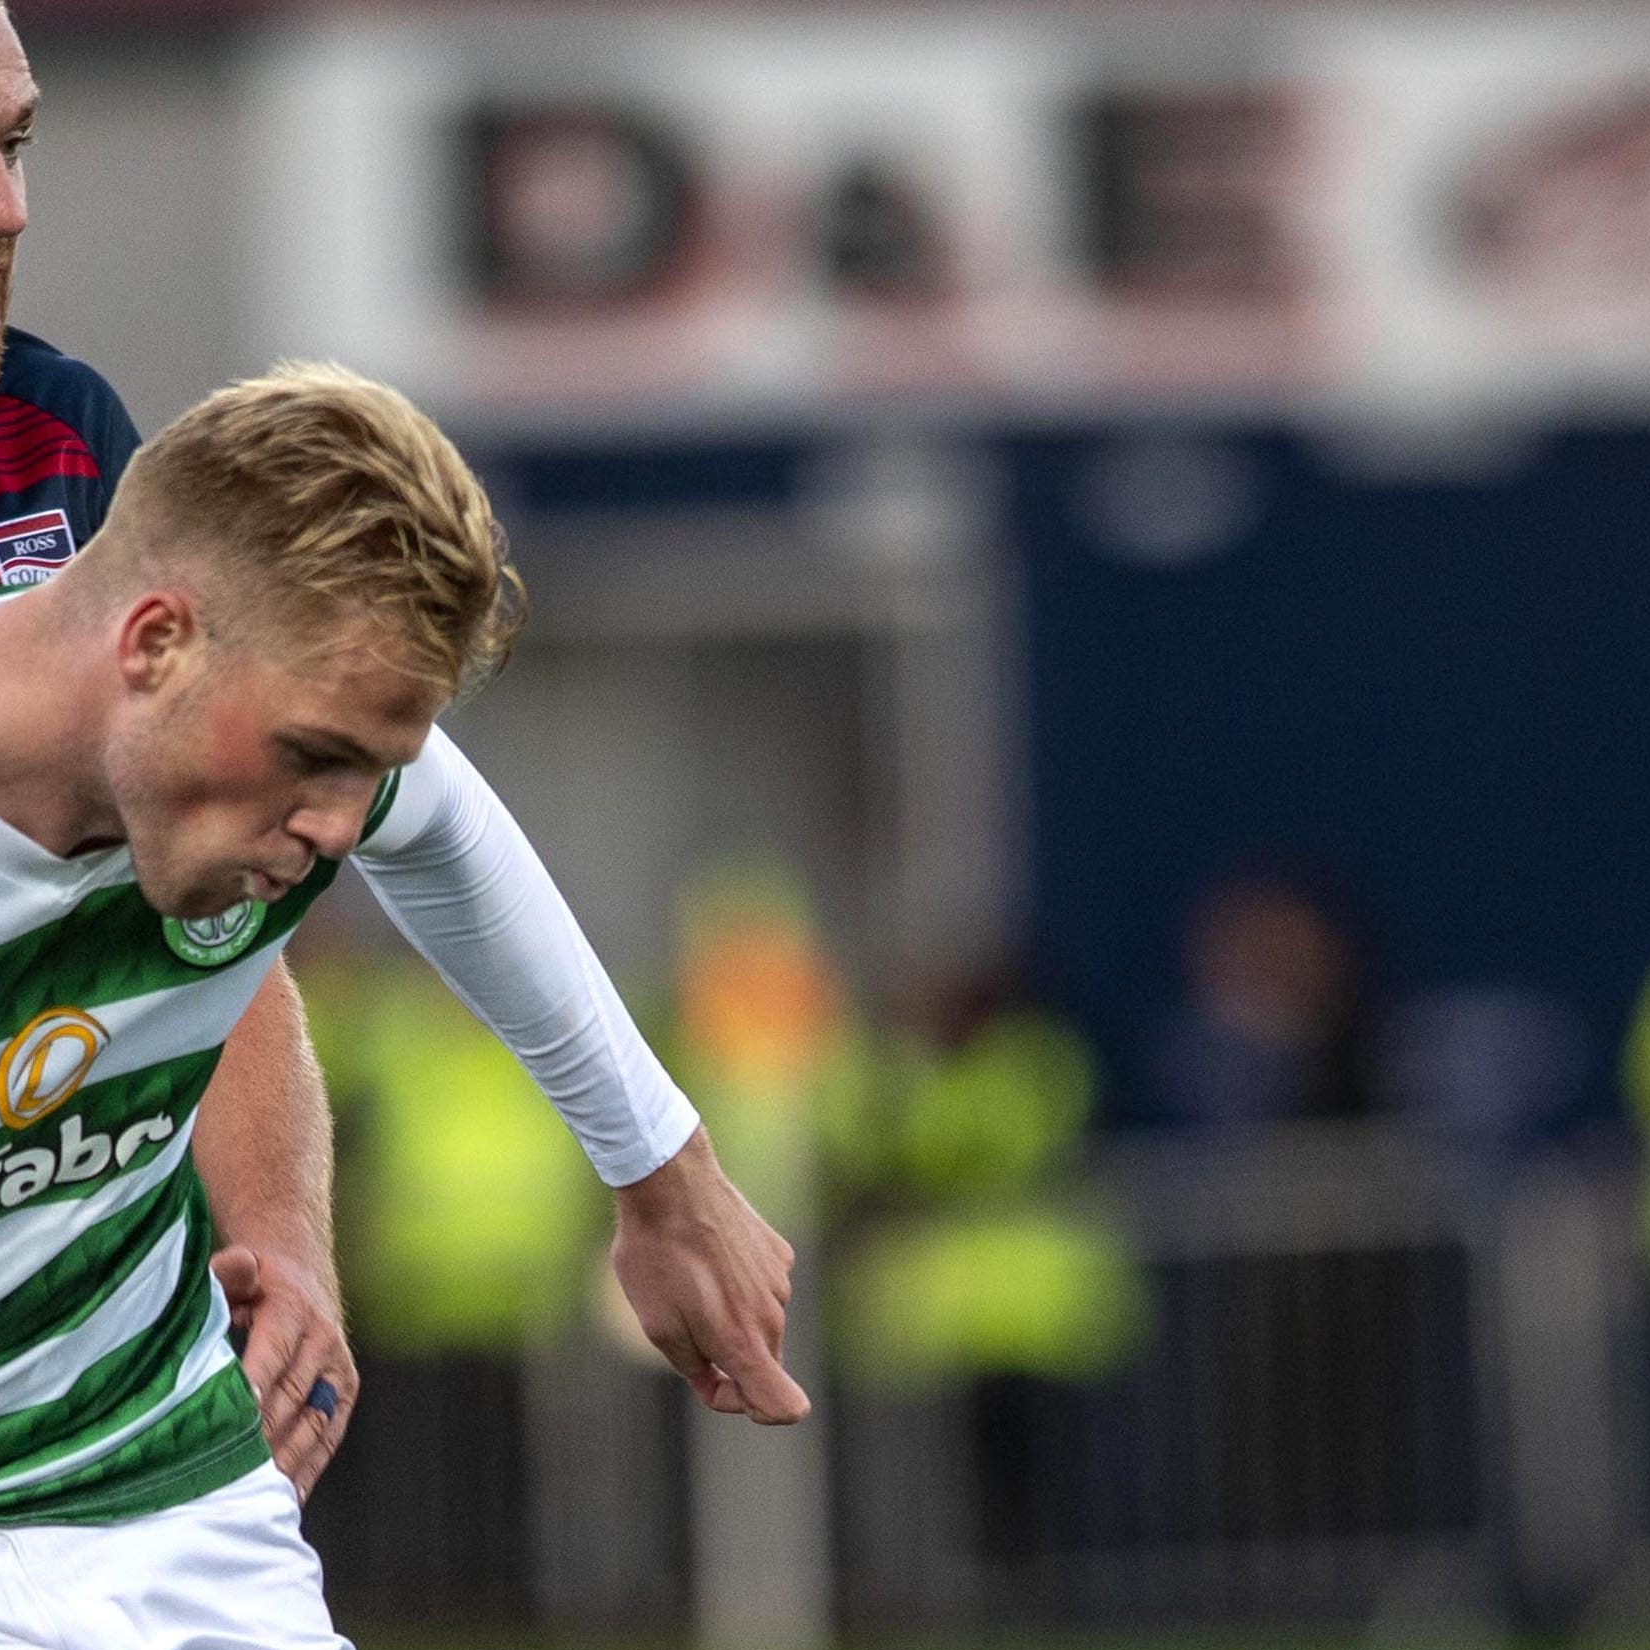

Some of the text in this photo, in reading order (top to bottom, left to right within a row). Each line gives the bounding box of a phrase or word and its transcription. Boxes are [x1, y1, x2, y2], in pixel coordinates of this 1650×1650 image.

[439, 92, 701, 315] D
[13, 533, 57, 556] ROSS
[8, 568, 52, 584] COU
